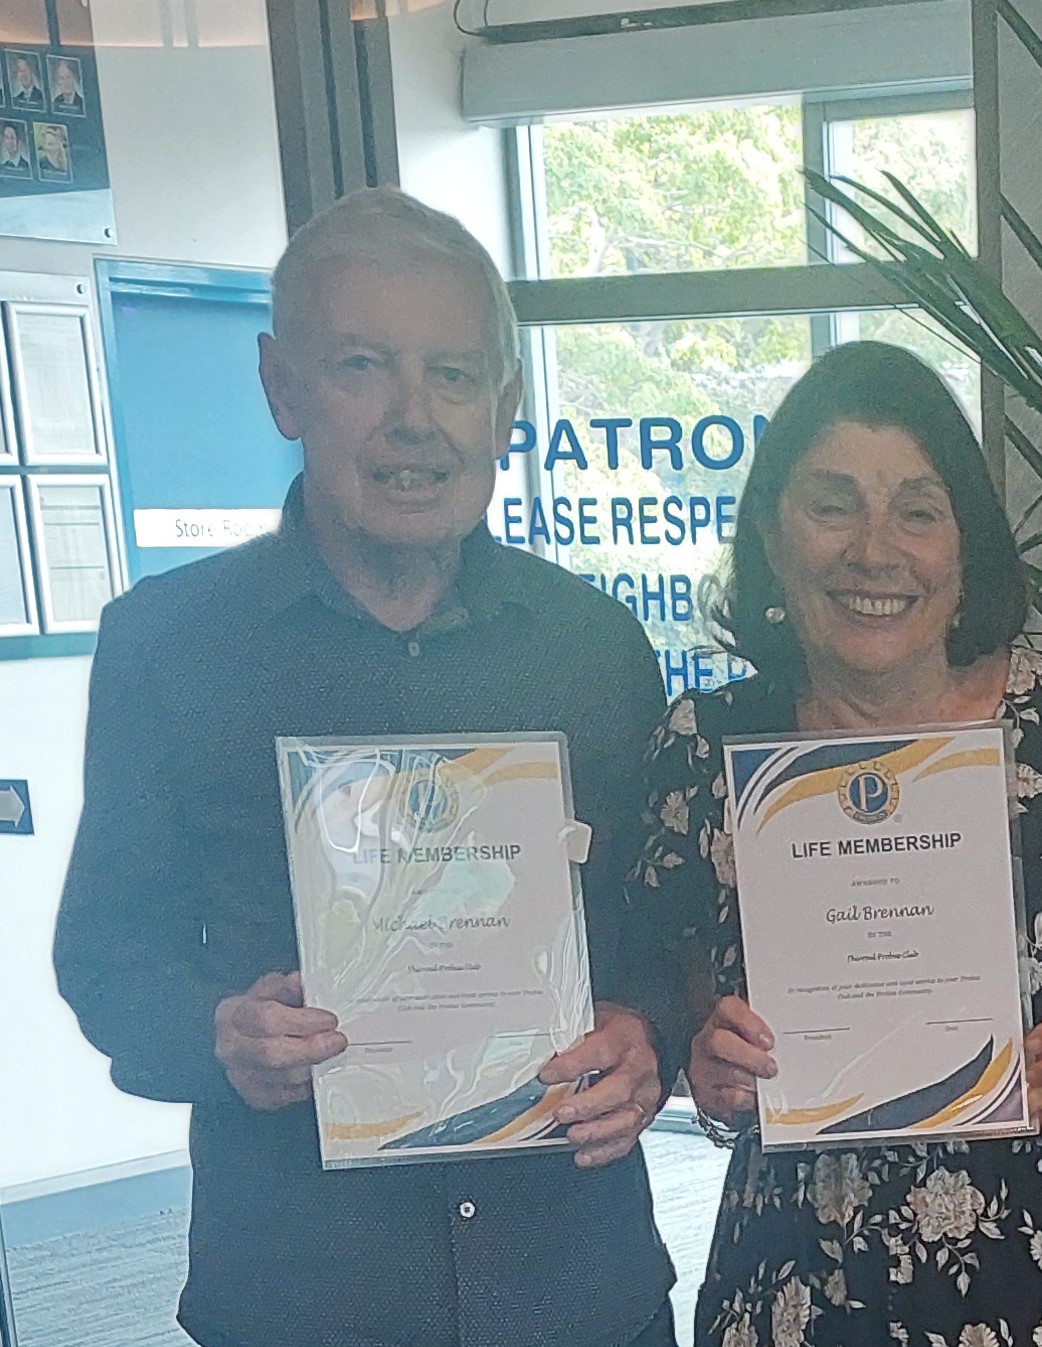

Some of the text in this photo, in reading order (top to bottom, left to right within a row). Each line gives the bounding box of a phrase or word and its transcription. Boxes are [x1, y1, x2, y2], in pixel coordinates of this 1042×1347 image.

[482, 496, 601, 546] EASE
[656, 649, 713, 697] HE
[352, 848, 392, 865] LIFE
[791, 832, 962, 859] LIFE MEMBERSHIP
[825, 904, 935, 925] Gail Brennan
